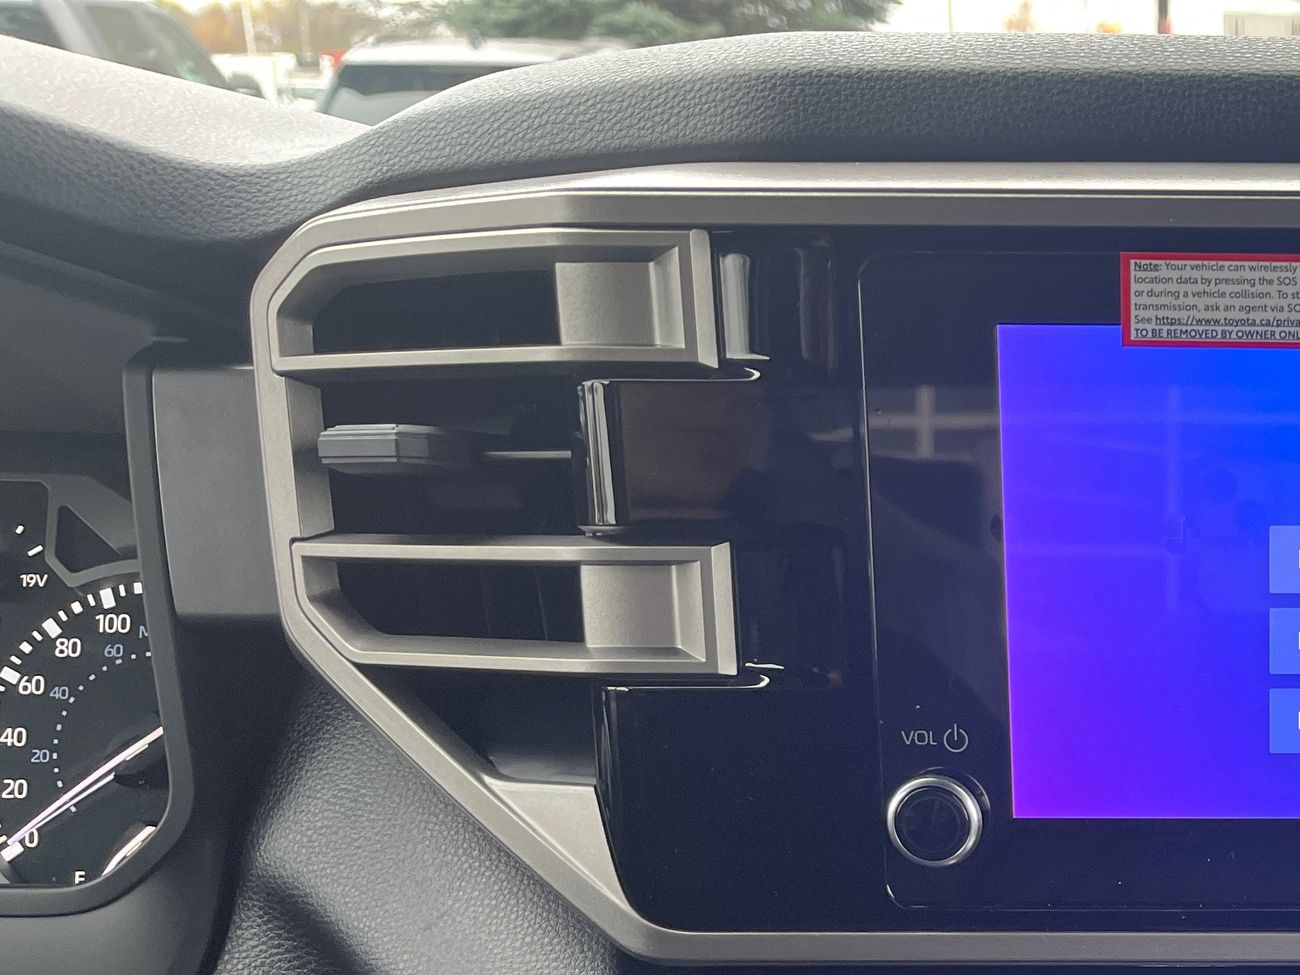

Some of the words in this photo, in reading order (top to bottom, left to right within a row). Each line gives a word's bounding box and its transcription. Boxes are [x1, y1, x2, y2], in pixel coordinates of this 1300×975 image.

[1134, 261, 1161, 272] Note:
[1165, 262, 1187, 271] Your
[1190, 262, 1225, 271] vehicle
[1228, 264, 1245, 272] can
[1248, 263, 1297, 274] wirelessly
[1134, 275, 1173, 284] location
[1176, 275, 1198, 284] data
[1200, 275, 1212, 286] by
[1214, 276, 1256, 287] pressing
[1258, 276, 1275, 285] the
[1276, 276, 1297, 286] SOS
[1146, 288, 1180, 300] during
[1191, 289, 1226, 298] vehicle
[1229, 289, 1274, 299] collision.
[1277, 290, 1288, 299] To
[1134, 302, 1201, 312] transmission,
[1204, 302, 1220, 311] ask
[1238, 304, 1268, 314] agent
[1270, 304, 1284, 312] via
[1134, 315, 1153, 324] See
[1134, 328, 1148, 338] TO
[1151, 328, 1164, 339] BE
[1167, 329, 1218, 339] REMOVED
[1221, 329, 1233, 339] BY
[1236, 329, 1276, 340] OWNER
[20, 574, 48, 588] 19V
[95, 613, 131, 634] 100
[55, 638, 82, 658] 80
[104, 644, 124, 658] 60
[18, 675, 45, 695] 60
[49, 686, 69, 699] 40
[0, 727, 27, 747] 40
[901, 730, 938, 745] VOL
[30, 750, 50, 762] 20
[1, 779, 28, 799] 20
[24, 828, 38, 848] 0
